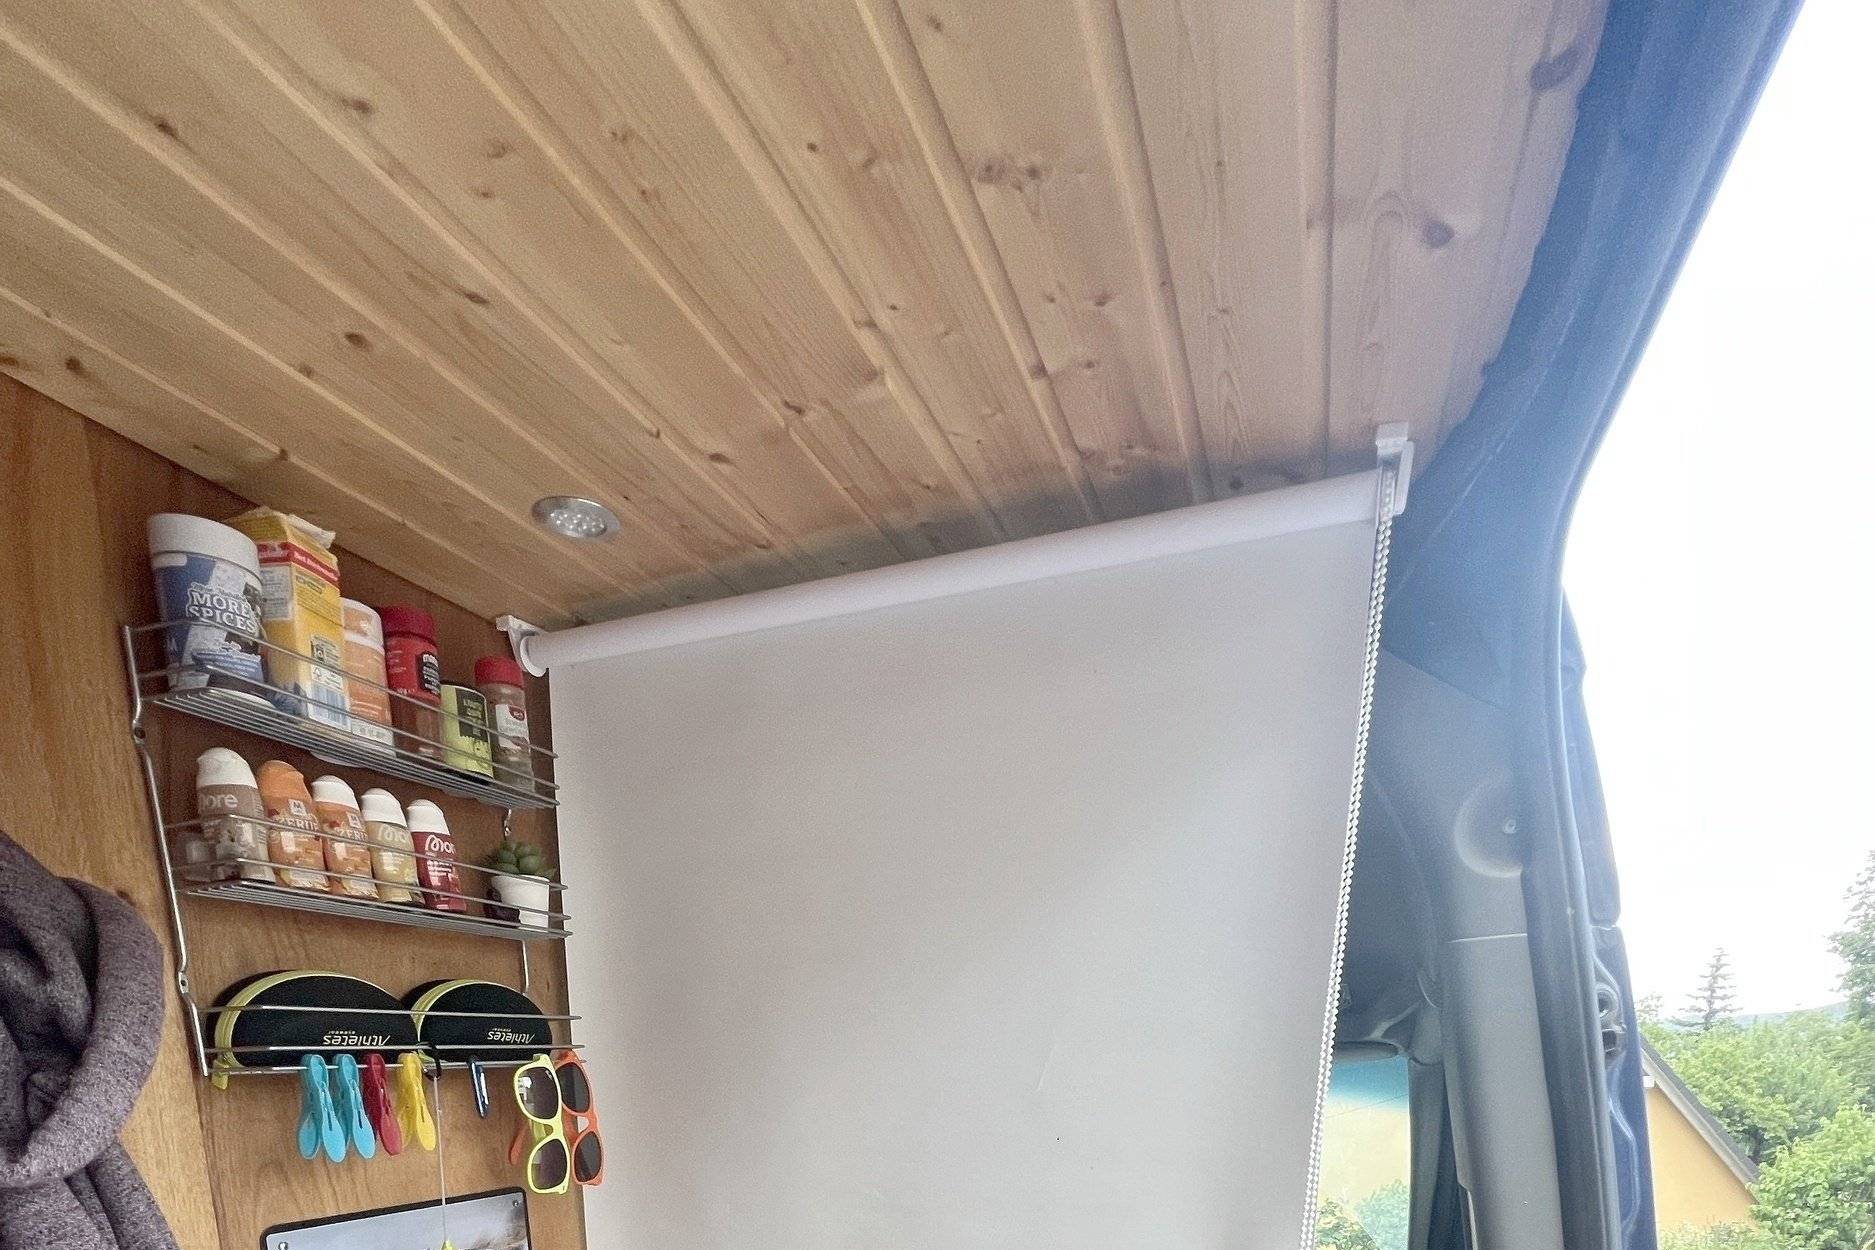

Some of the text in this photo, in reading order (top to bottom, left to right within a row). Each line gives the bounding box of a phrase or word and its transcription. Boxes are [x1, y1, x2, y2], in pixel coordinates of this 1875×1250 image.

[191, 591, 251, 618] MORE
[188, 606, 258, 634] SPICES
[323, 1034, 390, 1046] Athletes
[487, 1031, 535, 1045] Athletes
